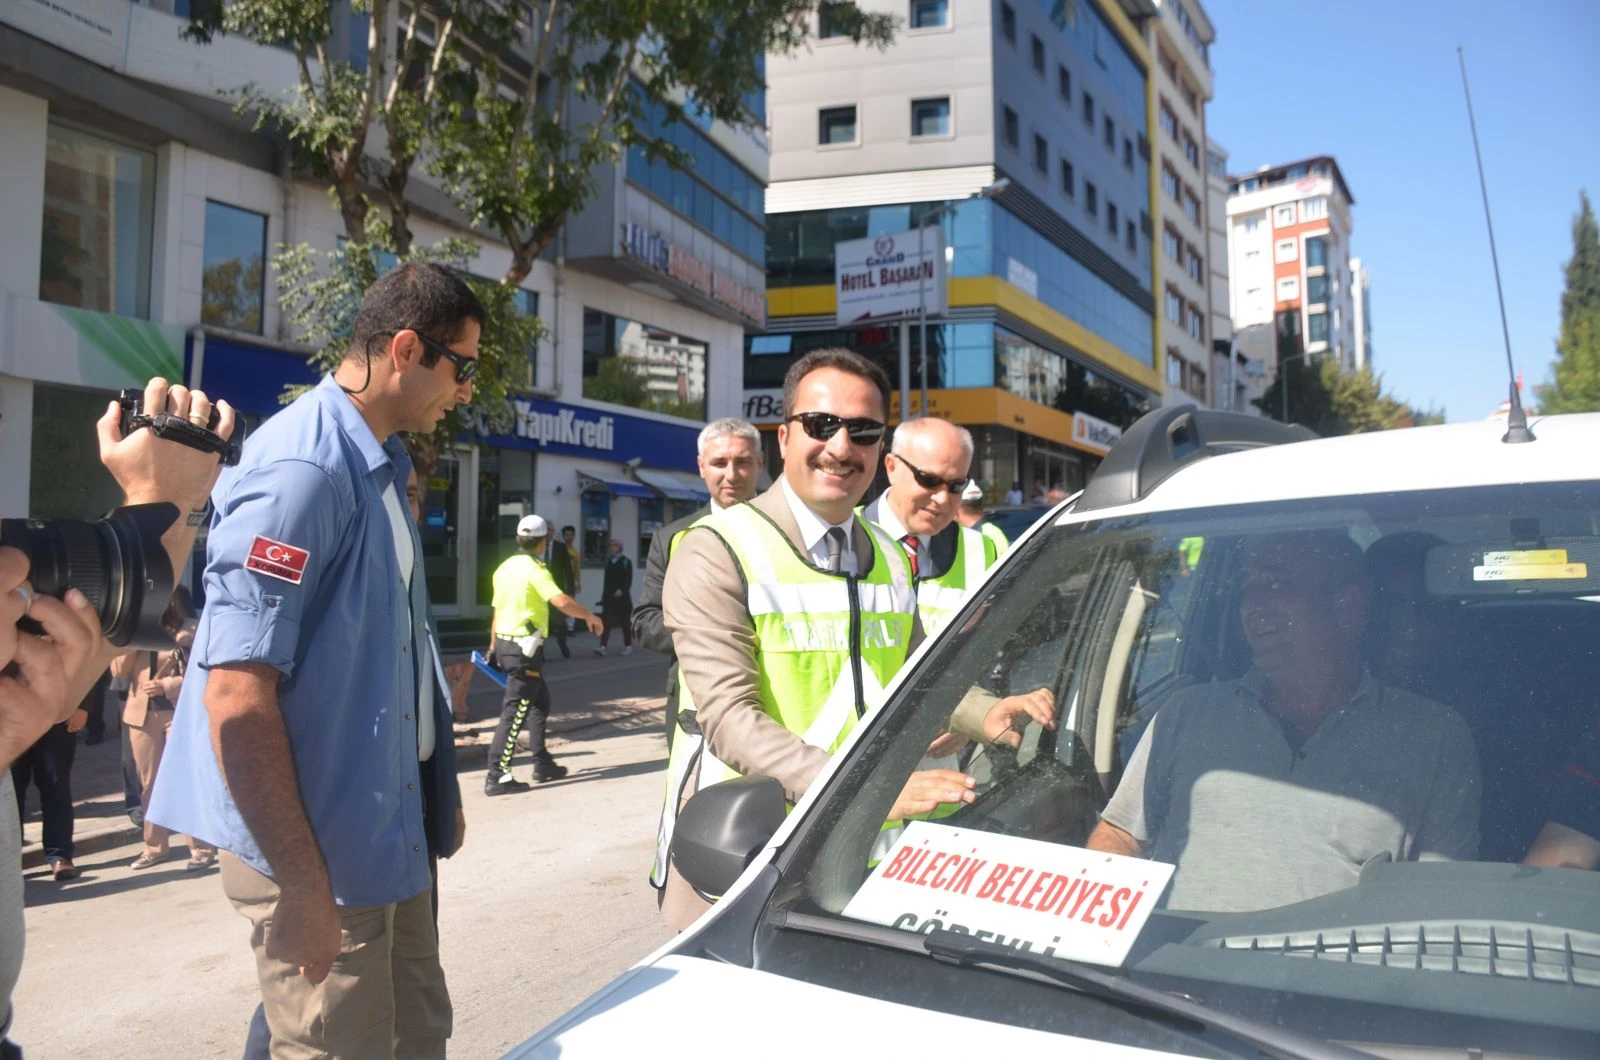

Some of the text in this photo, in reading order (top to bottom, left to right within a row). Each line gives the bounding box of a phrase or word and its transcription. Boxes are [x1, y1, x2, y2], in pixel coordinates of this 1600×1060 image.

[841, 270, 876, 292] HOTEL
[881, 840, 1149, 931] BİLECİK BELEDİYESİ
